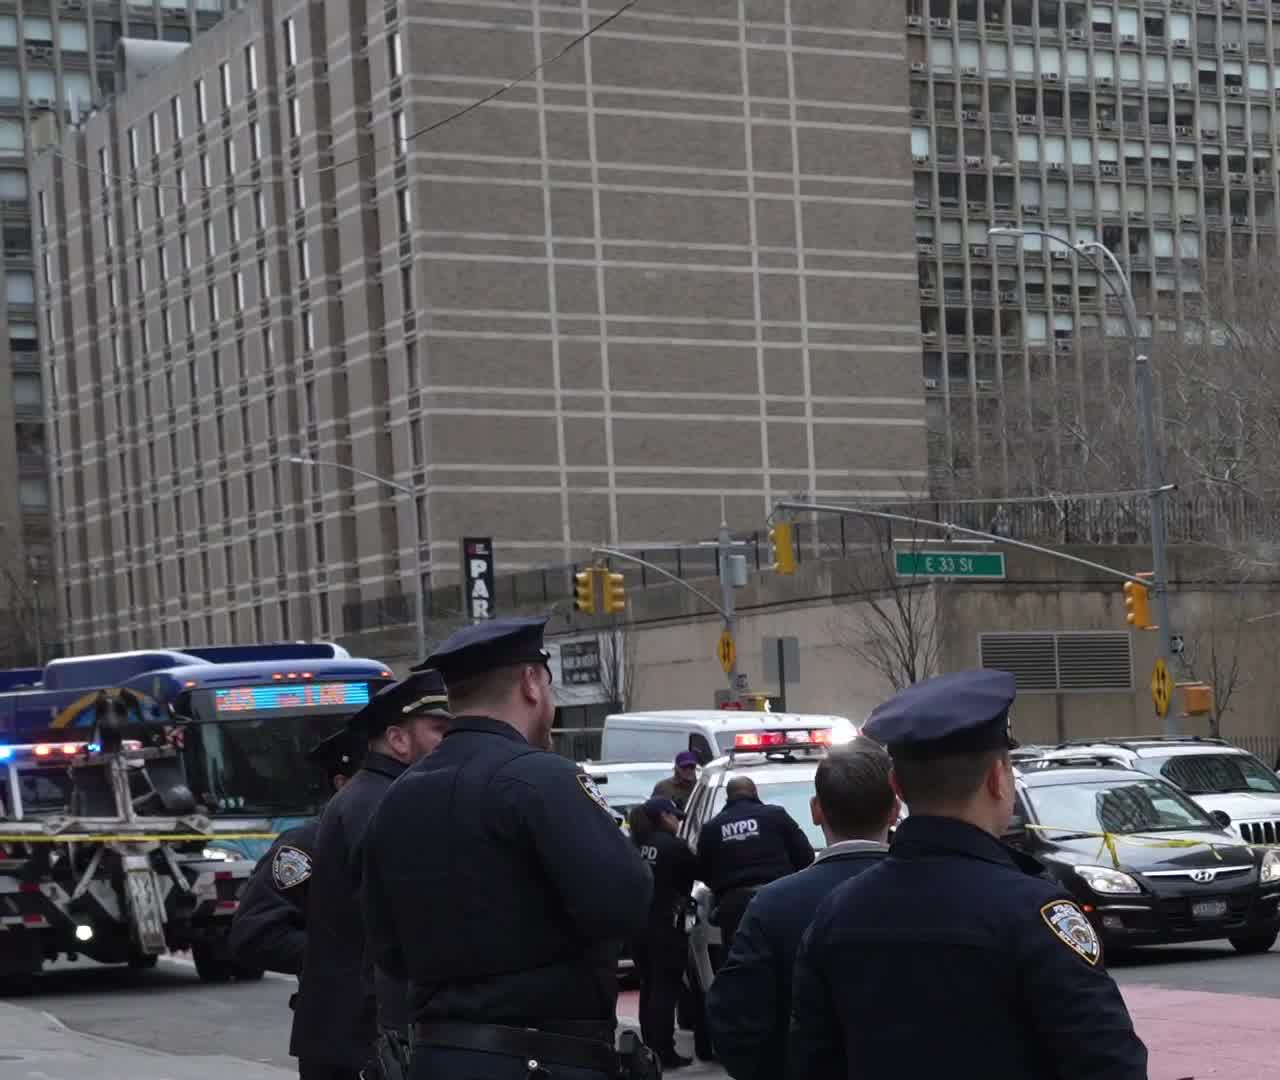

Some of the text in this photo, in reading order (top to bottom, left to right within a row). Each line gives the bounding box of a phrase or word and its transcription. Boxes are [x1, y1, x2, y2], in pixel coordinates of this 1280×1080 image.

[925, 556, 935, 573] E
[939, 556, 955, 573] 33
[470, 559, 490, 625] PAR
[721, 819, 758, 837] NYPD
[640, 846, 658, 860] PD
